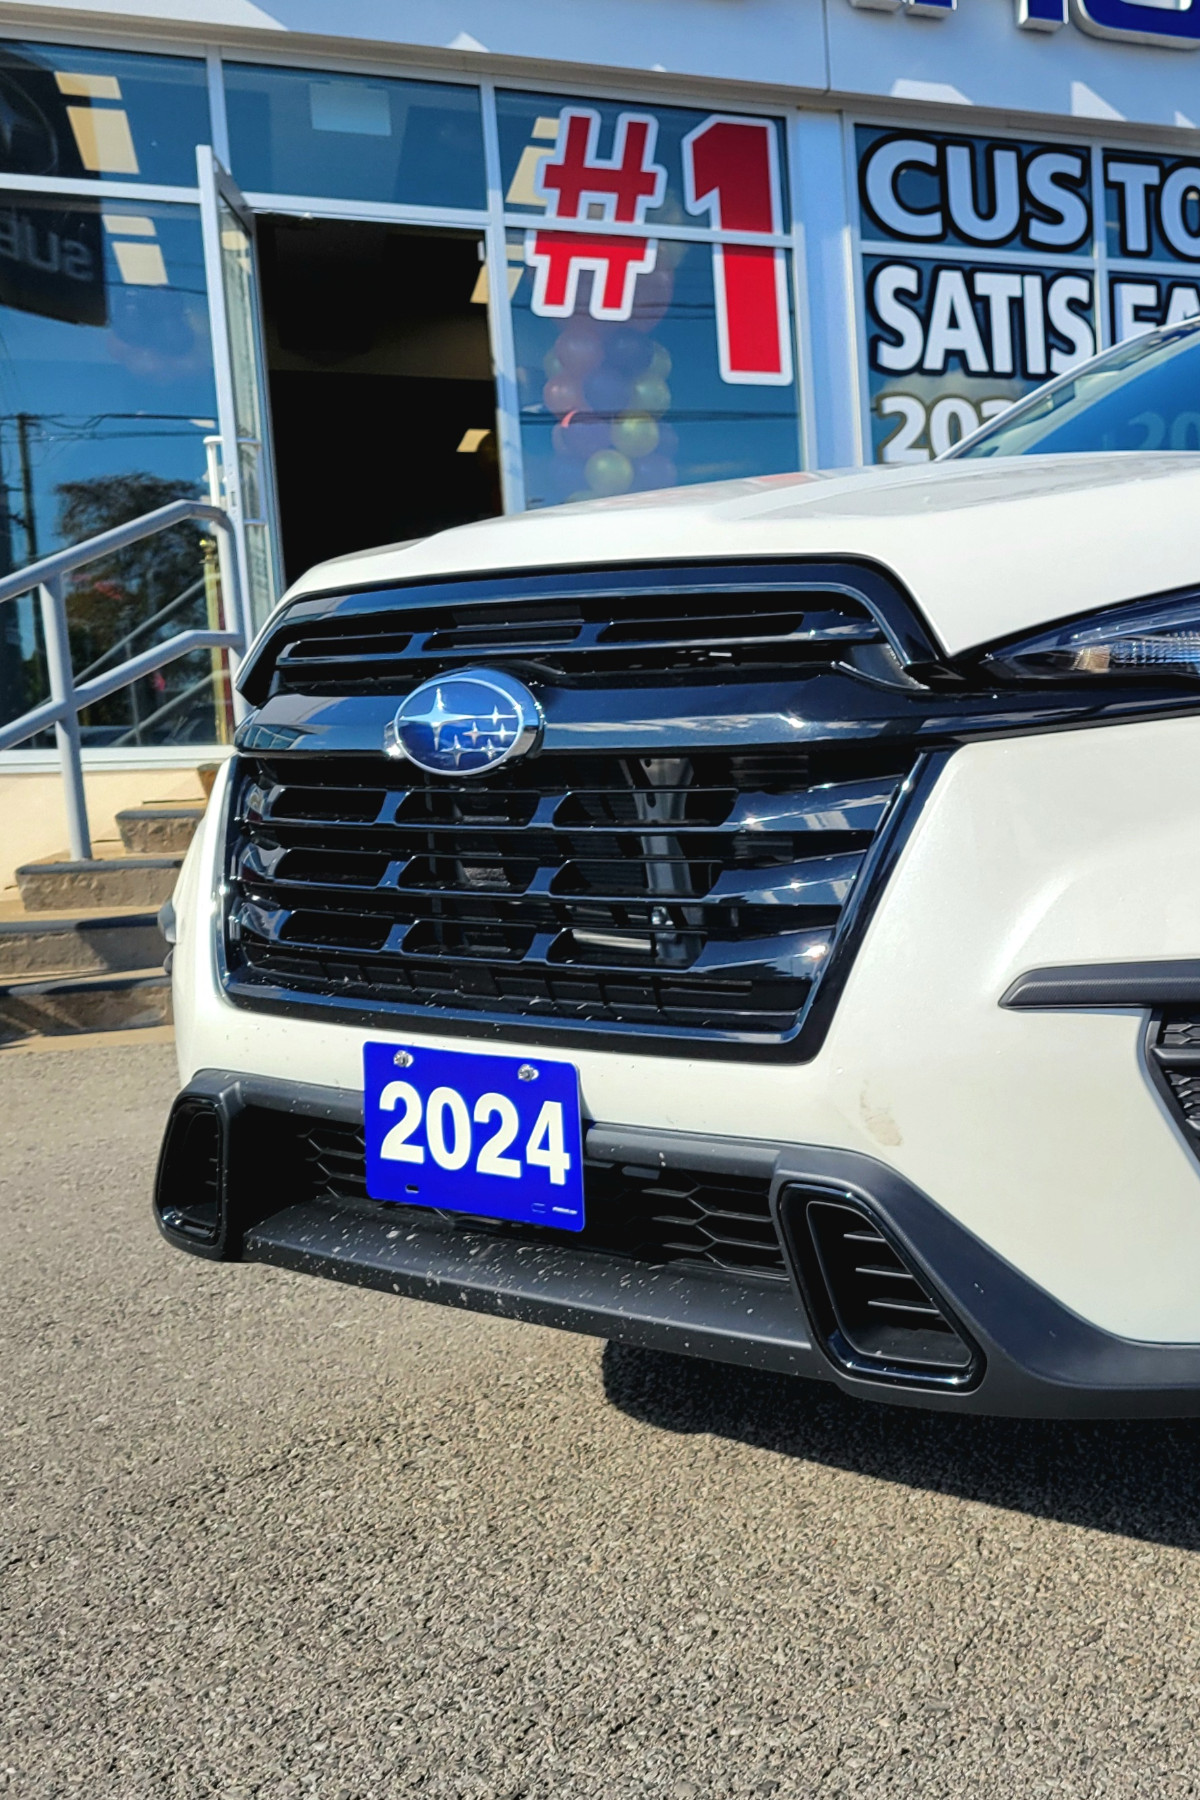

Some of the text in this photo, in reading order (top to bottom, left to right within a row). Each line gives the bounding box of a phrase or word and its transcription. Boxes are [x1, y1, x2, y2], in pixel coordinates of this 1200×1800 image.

[524, 107, 793, 385] #1
[878, 394, 1013, 464] 20
[378, 1079, 572, 1186] 2024
